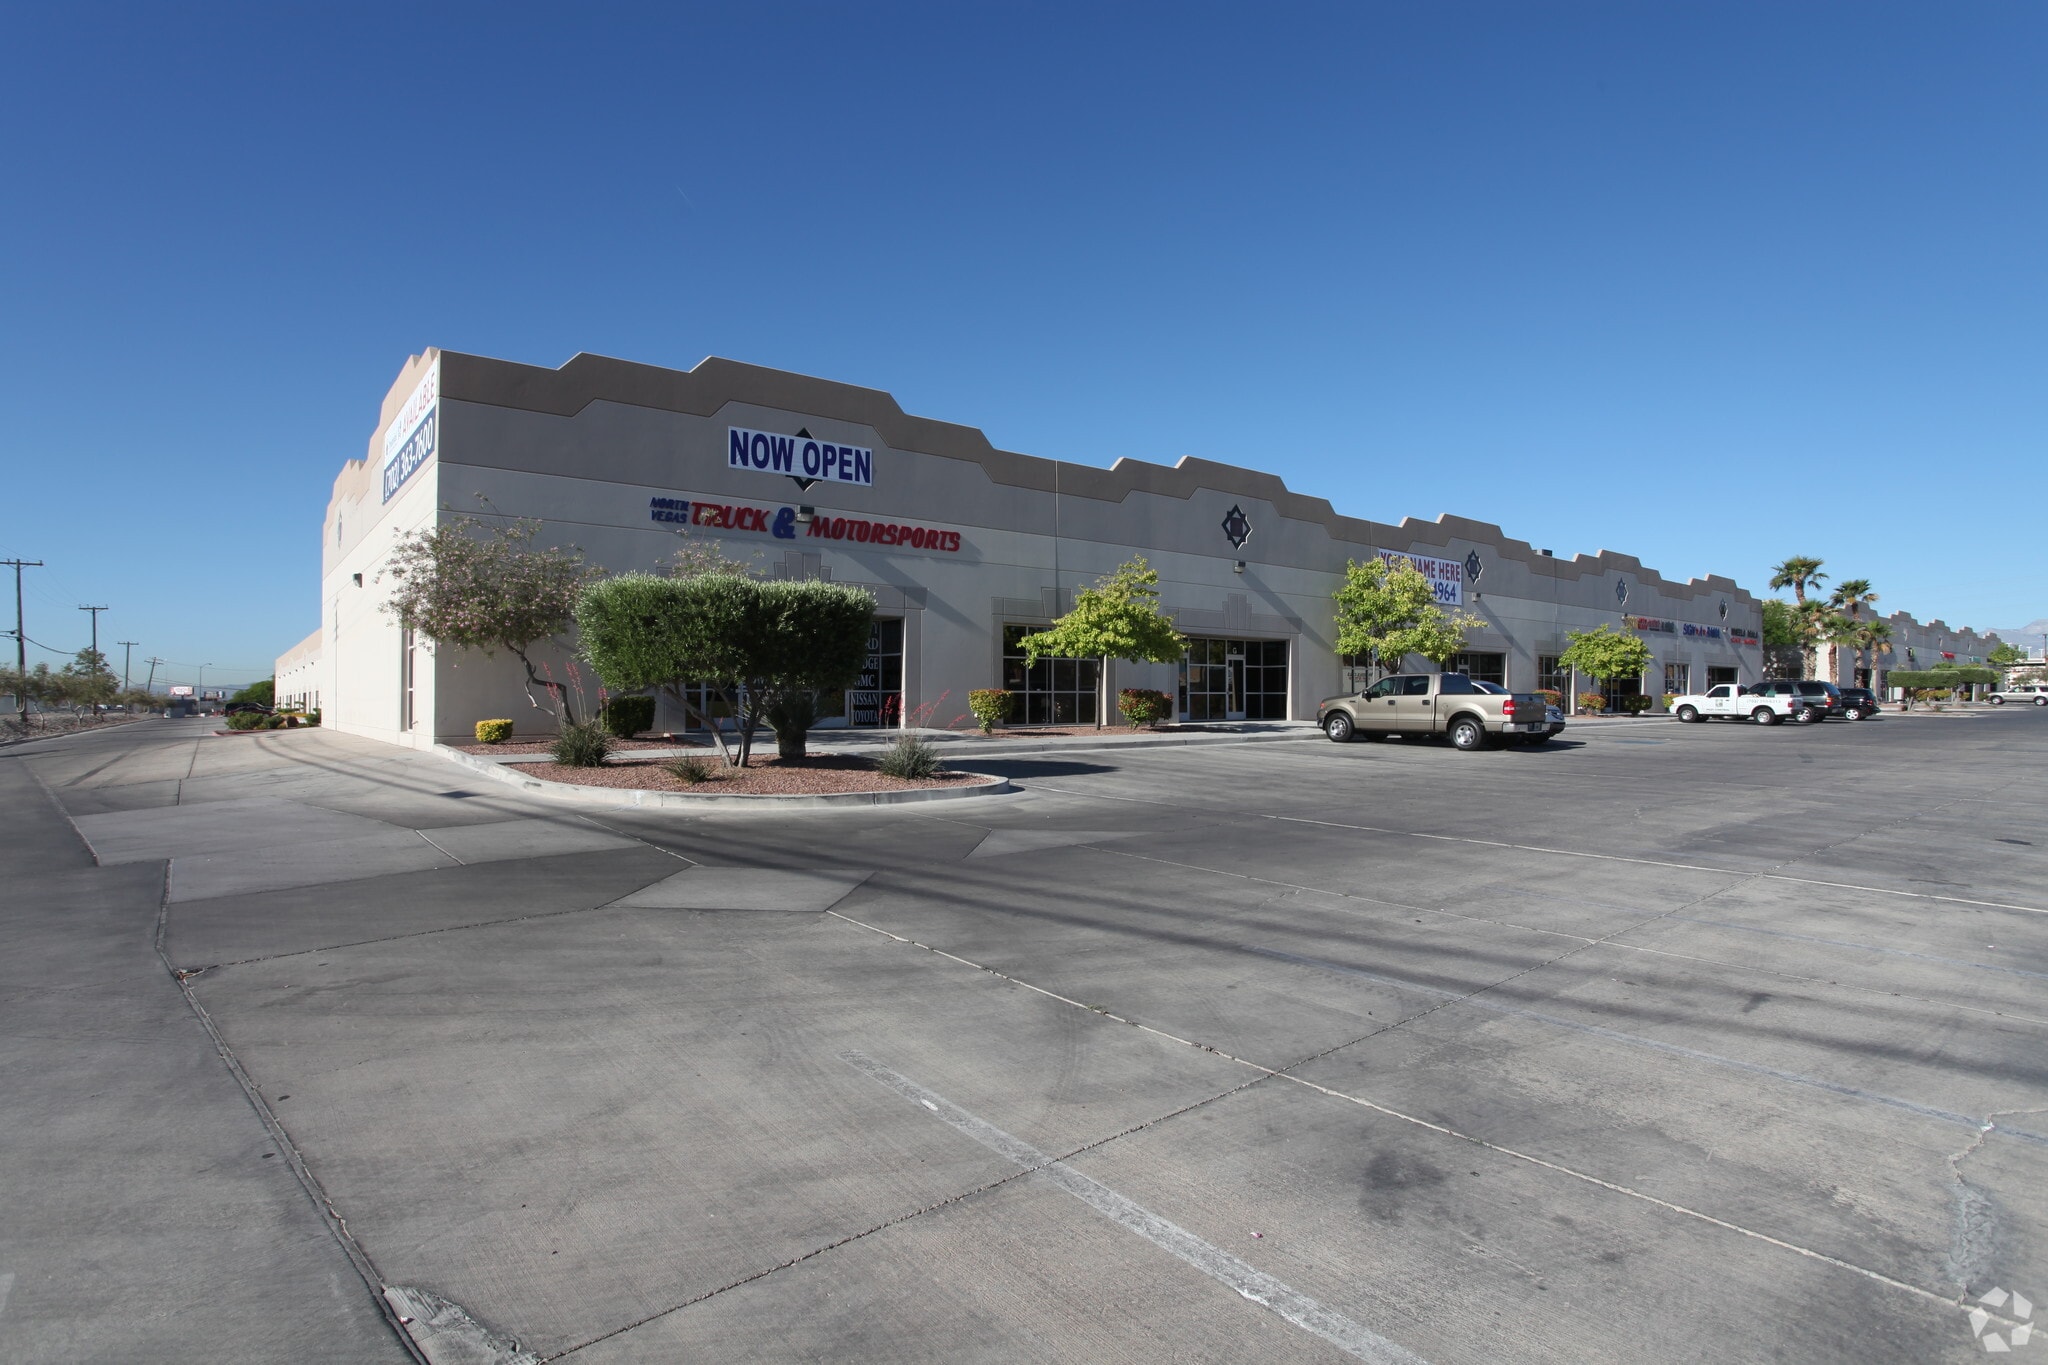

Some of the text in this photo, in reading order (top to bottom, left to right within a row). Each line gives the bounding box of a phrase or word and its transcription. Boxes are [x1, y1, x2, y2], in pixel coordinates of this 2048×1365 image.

[400, 417, 433, 481] 363-7600
[730, 429, 871, 484] NOW OPEN
[650, 497, 689, 511] NORTH
[651, 510, 687, 524] VEGAS
[691, 501, 961, 552] TRUCK & MOTORSPORTS
[1410, 557, 1436, 579] NAME
[1438, 562, 1461, 583] HERE
[851, 692, 878, 705] NISSAN
